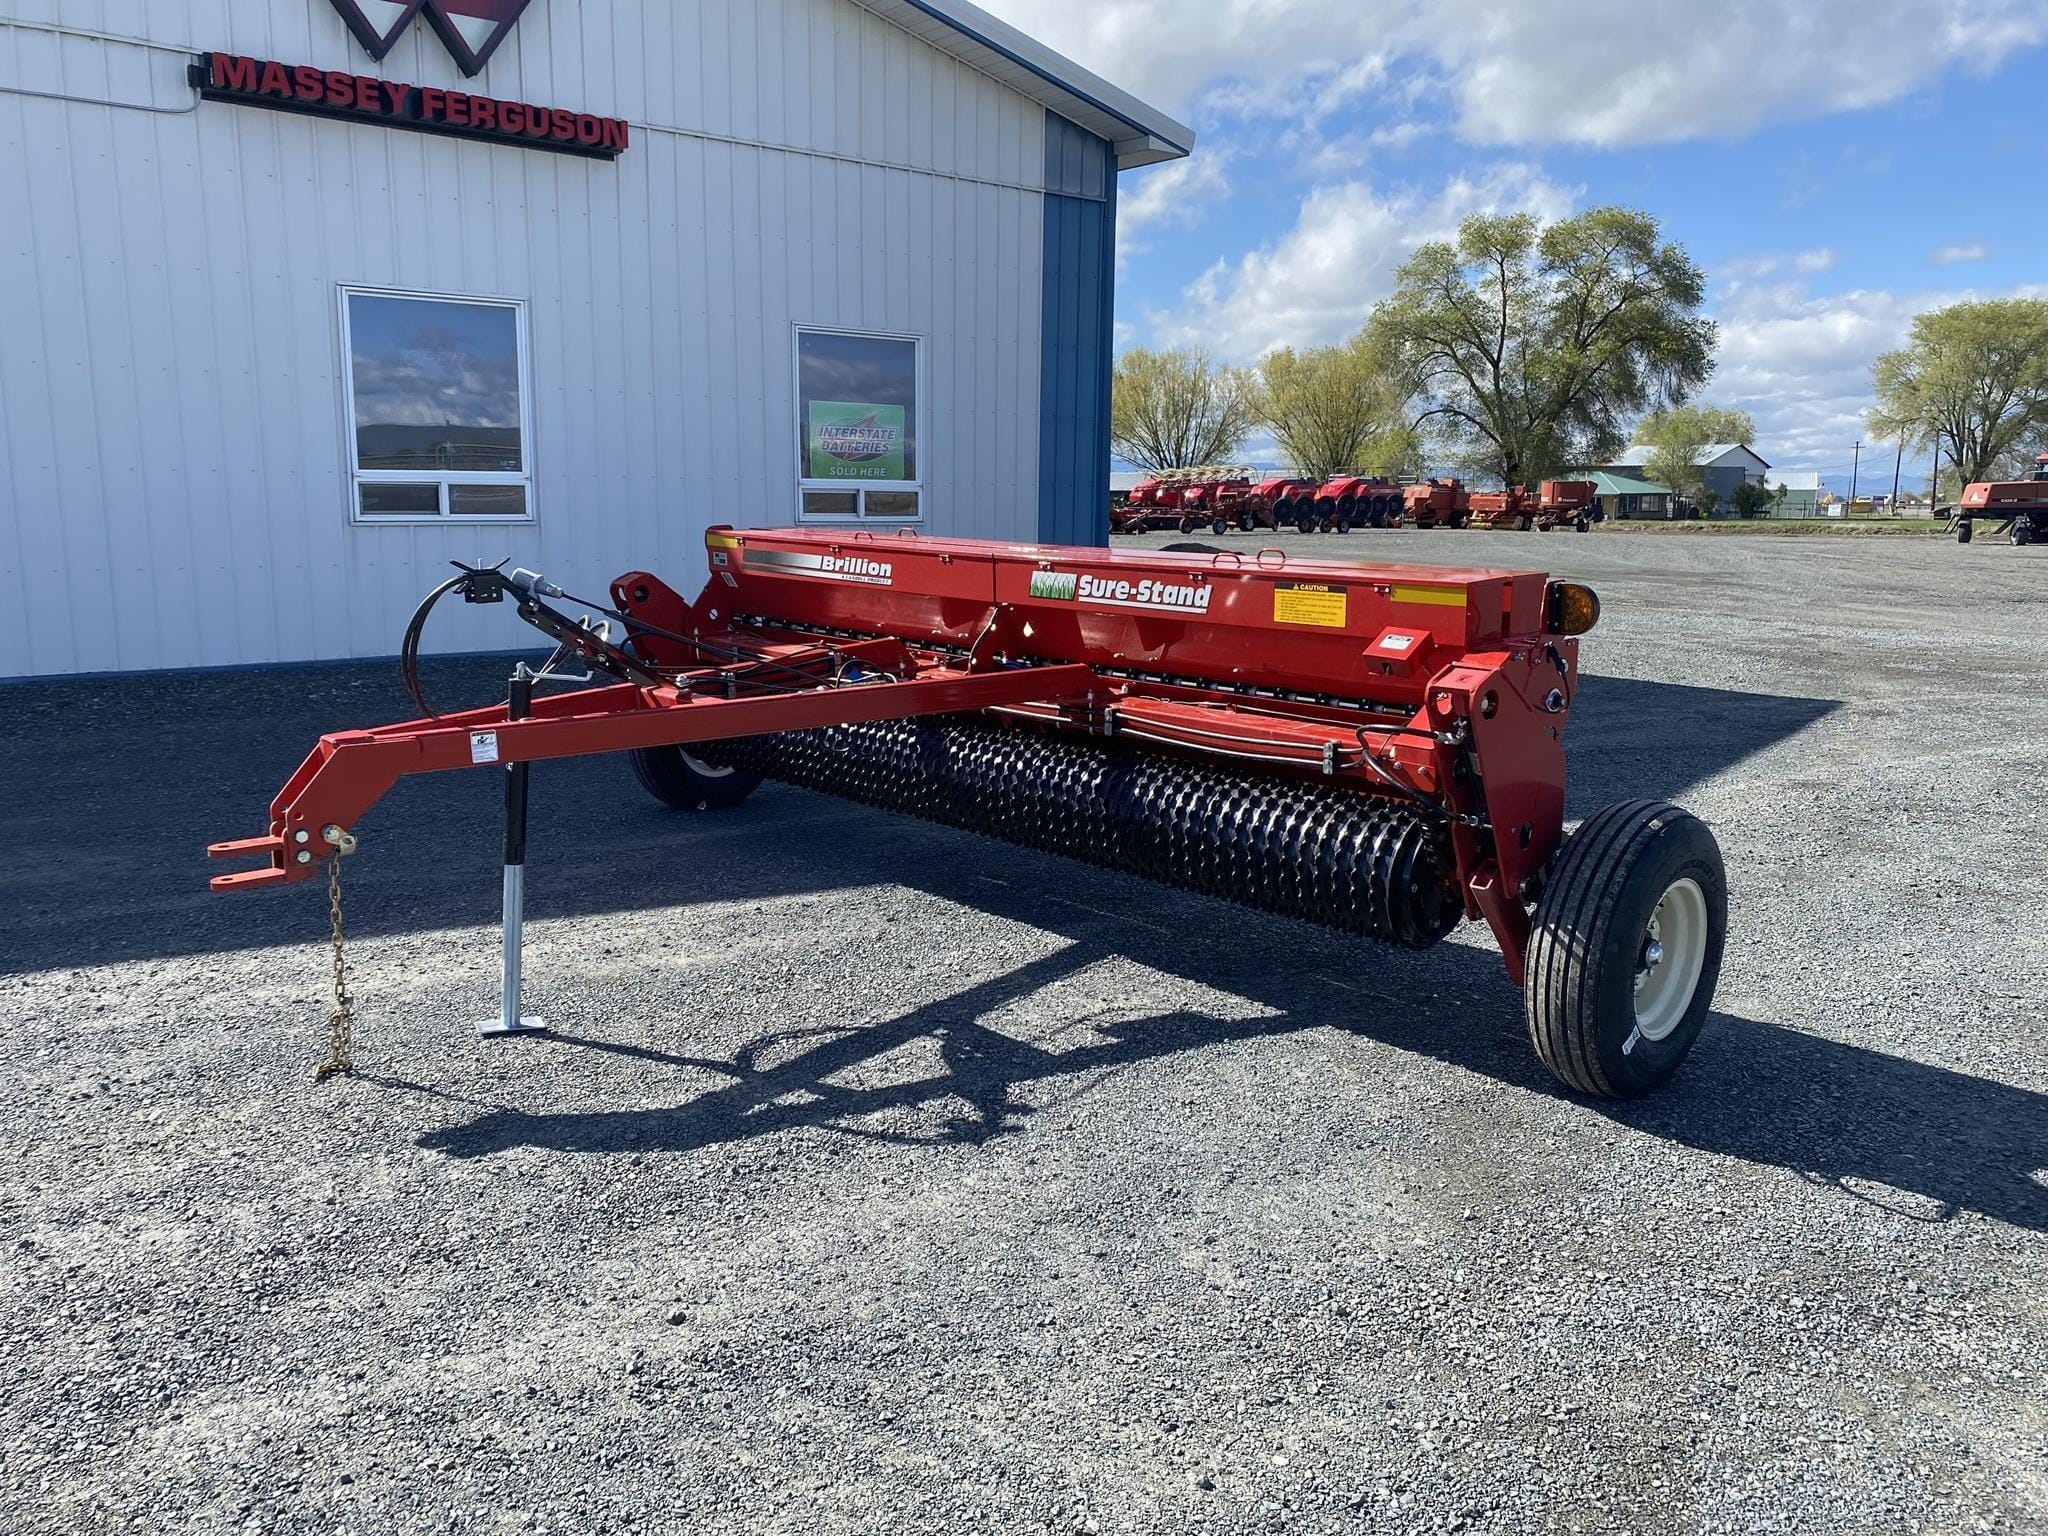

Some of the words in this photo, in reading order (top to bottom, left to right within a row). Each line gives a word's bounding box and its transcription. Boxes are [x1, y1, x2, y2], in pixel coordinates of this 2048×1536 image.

[211, 52, 412, 114] MASSEY
[420, 87, 629, 149] FERGUSON
[818, 426, 897, 440] INTERSTATE
[821, 439, 890, 453] BATTERIES
[829, 466, 857, 476] SOLD
[860, 467, 887, 476] HERE
[822, 556, 892, 577] Brillion
[1078, 574, 1212, 607] Sure-Stand
[1299, 584, 1329, 592] CAUTION
